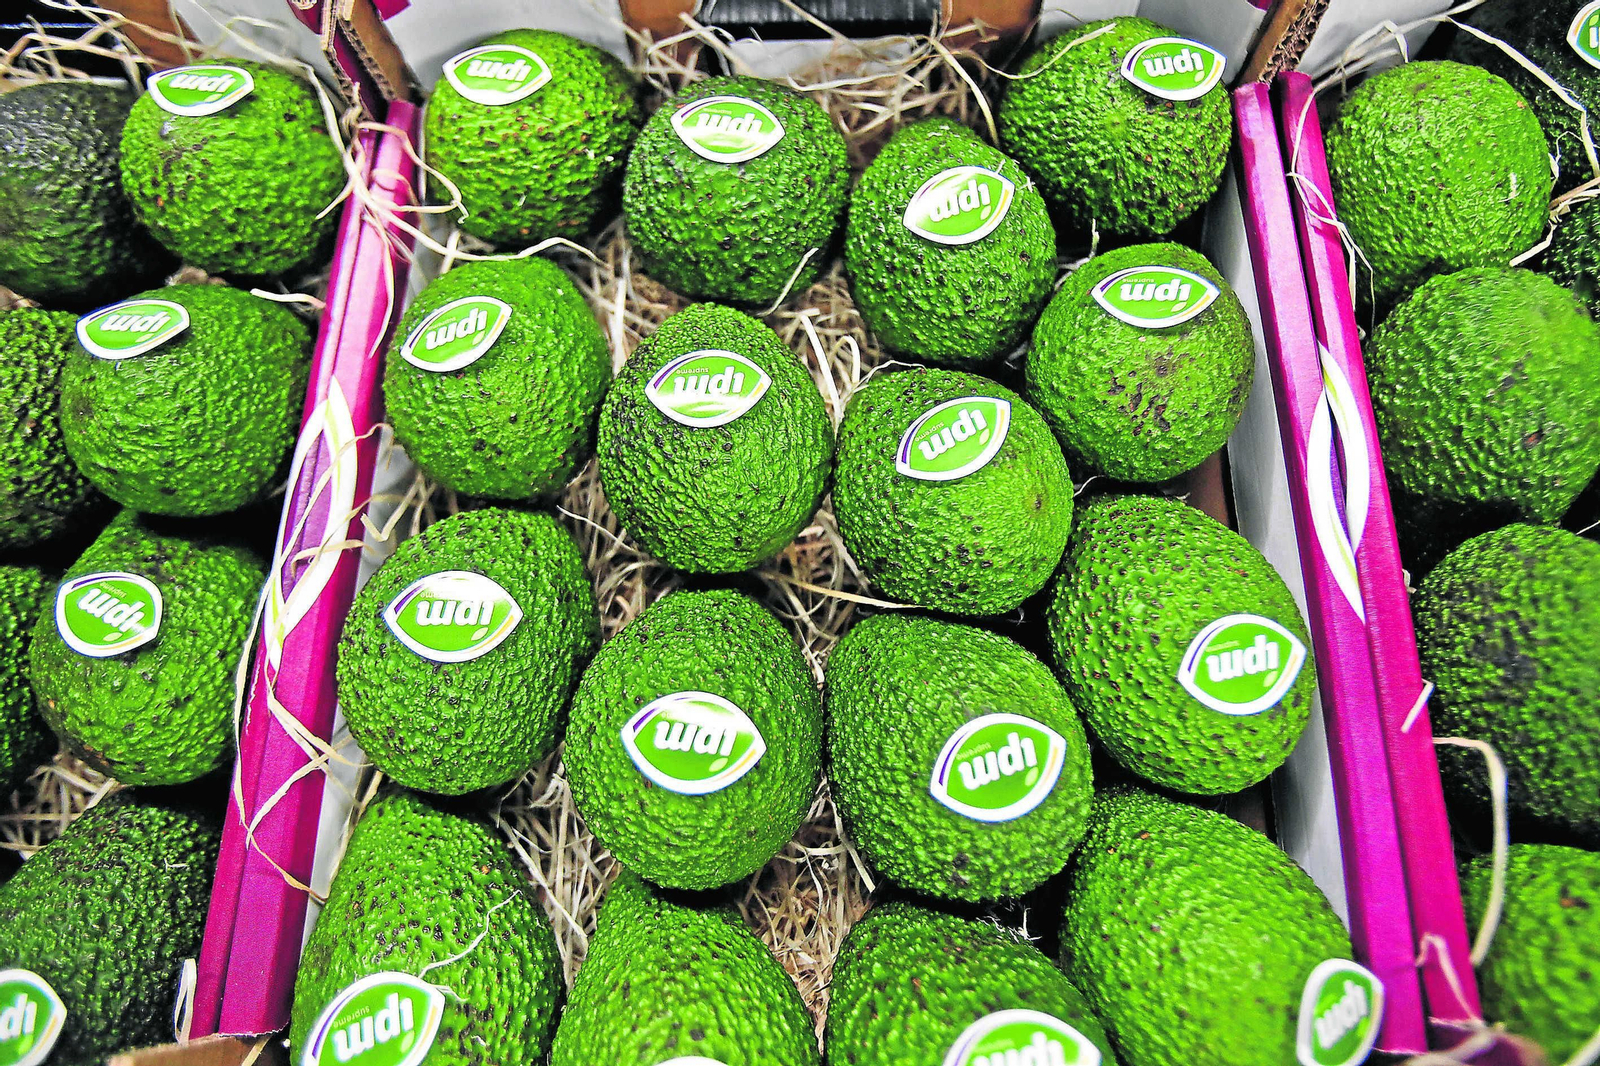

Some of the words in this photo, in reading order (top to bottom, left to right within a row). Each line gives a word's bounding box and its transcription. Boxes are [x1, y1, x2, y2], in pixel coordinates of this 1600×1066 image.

[465, 58, 532, 90] ipm
[1142, 48, 1205, 82] ipm
[169, 73, 234, 101] ipm
[697, 112, 763, 136] ipm
[1119, 279, 1192, 312] ipm
[100, 311, 172, 342] ipm
[425, 308, 488, 350] ipm
[673, 366, 745, 397] ipm
[676, 367, 709, 375] supreme
[915, 421, 944, 442] supreme
[918, 408, 988, 460] ipm
[76, 588, 146, 641] ipm
[416, 598, 495, 640] ipm
[1205, 634, 1280, 687] ipm
[654, 718, 738, 772] ipm
[957, 732, 1039, 791] ipm
[331, 992, 415, 1062] ipm
[333, 1005, 371, 1029] supreme
[1315, 980, 1369, 1050] ipm
